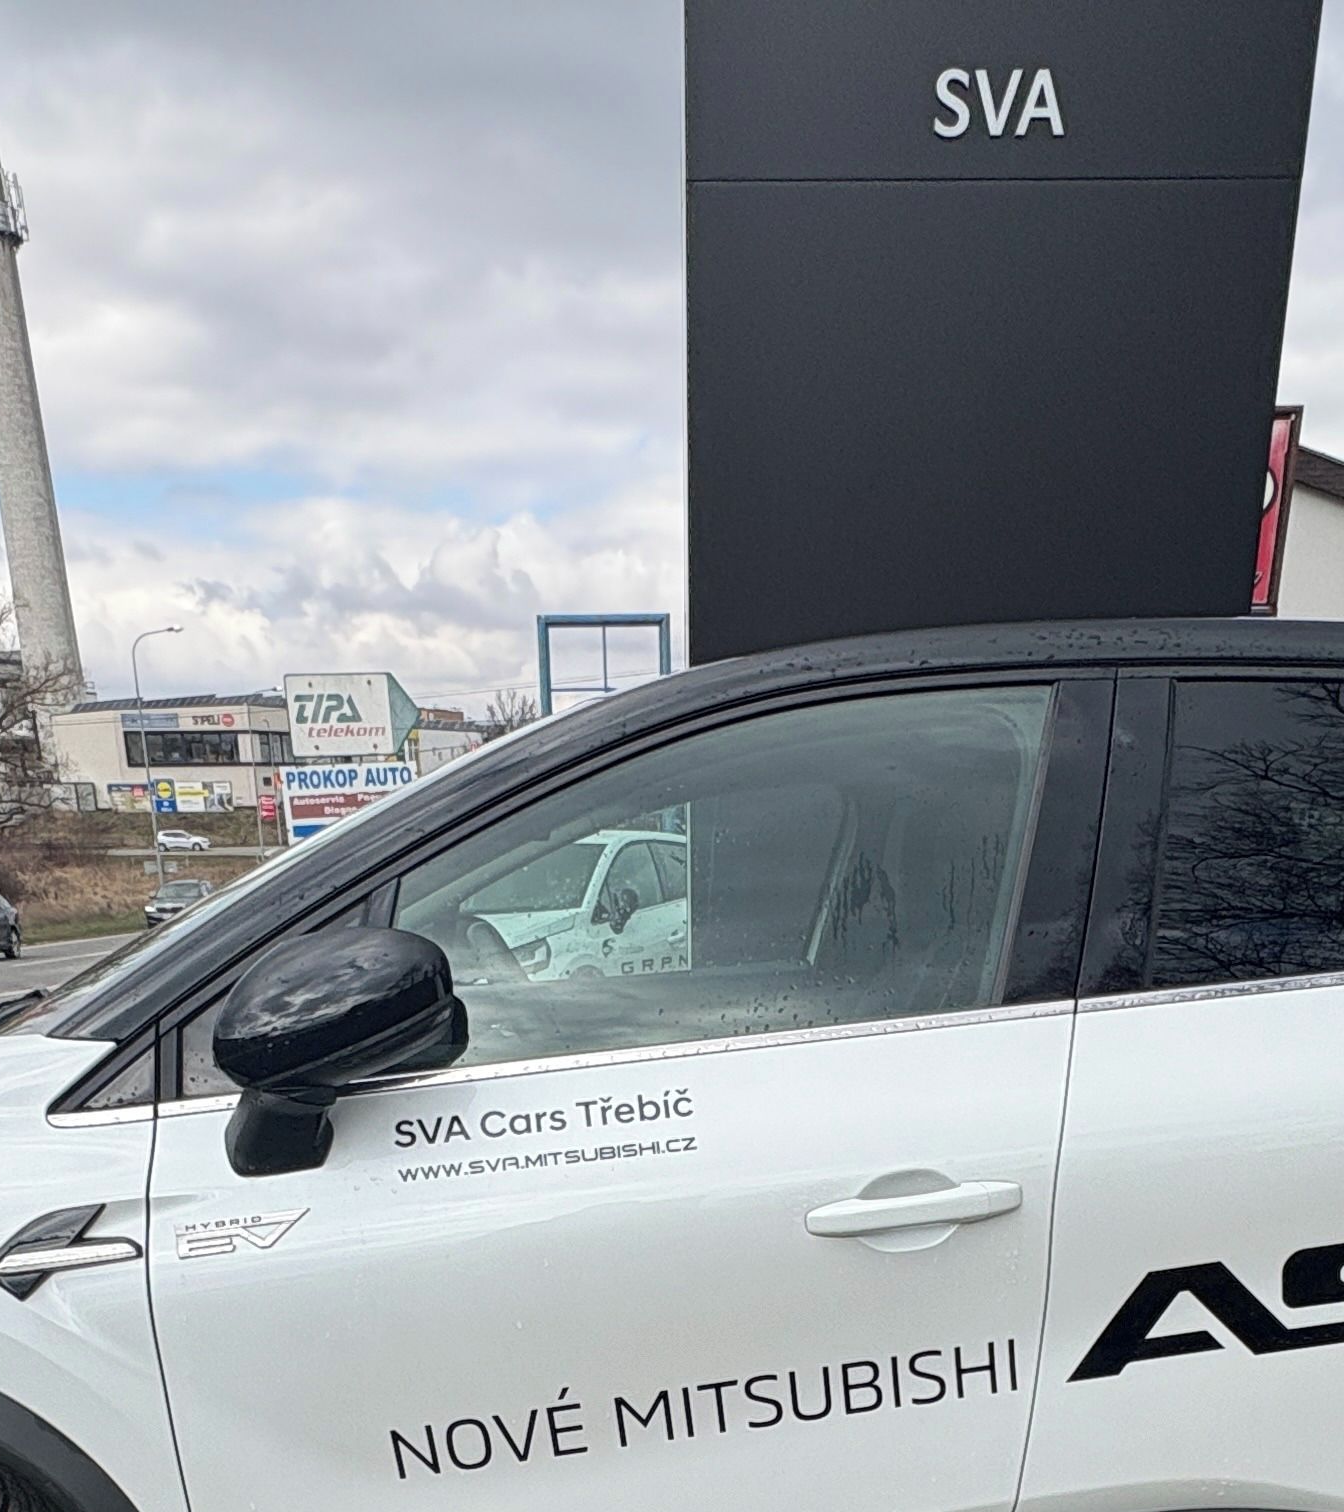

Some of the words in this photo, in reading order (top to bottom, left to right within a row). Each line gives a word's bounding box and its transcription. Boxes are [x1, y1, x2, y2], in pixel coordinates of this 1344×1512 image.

[934, 68, 1065, 138] SVA
[293, 694, 363, 724] TIPA
[308, 724, 386, 738] telekom
[286, 769, 358, 791] PROKOP
[364, 766, 413, 787] AUTO
[394, 1114, 471, 1148] SVA
[480, 1108, 567, 1138] Cars
[575, 1088, 694, 1127] Třebíč
[397, 1136, 698, 1182] WWW.SVA.MITSUBISHI.CZ
[185, 1215, 262, 1232] HYBRID
[390, 1386, 588, 1480] NOVÉ
[613, 1338, 1019, 1448] MITSUBISHI
